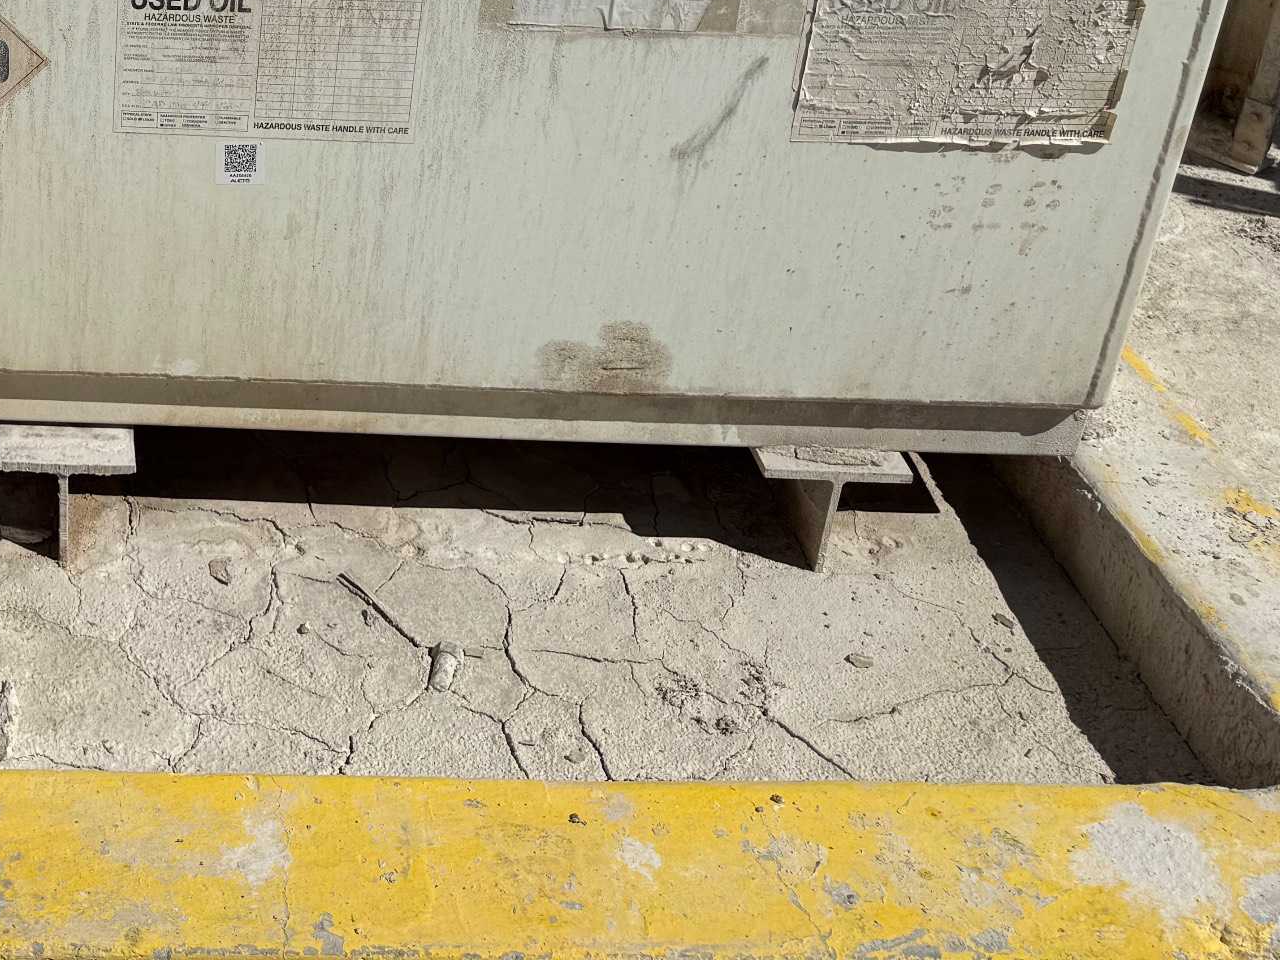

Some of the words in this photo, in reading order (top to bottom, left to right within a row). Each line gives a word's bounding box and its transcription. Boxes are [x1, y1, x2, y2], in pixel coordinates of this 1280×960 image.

[144, 13, 201, 23] HAZARDOUS
[203, 14, 236, 24] WASTE
[253, 122, 302, 131] HAZARDOUS
[304, 124, 330, 132] WASTE
[332, 125, 364, 133] HANDLE
[365, 126, 386, 134] WITH
[387, 127, 409, 135] CARE
[941, 127, 992, 136] HAZARDOUS
[994, 128, 1021, 137] WASTE
[1023, 128, 1057, 138] HANDLE
[1059, 128, 1081, 138] WITH
[1082, 129, 1105, 138] CARE
